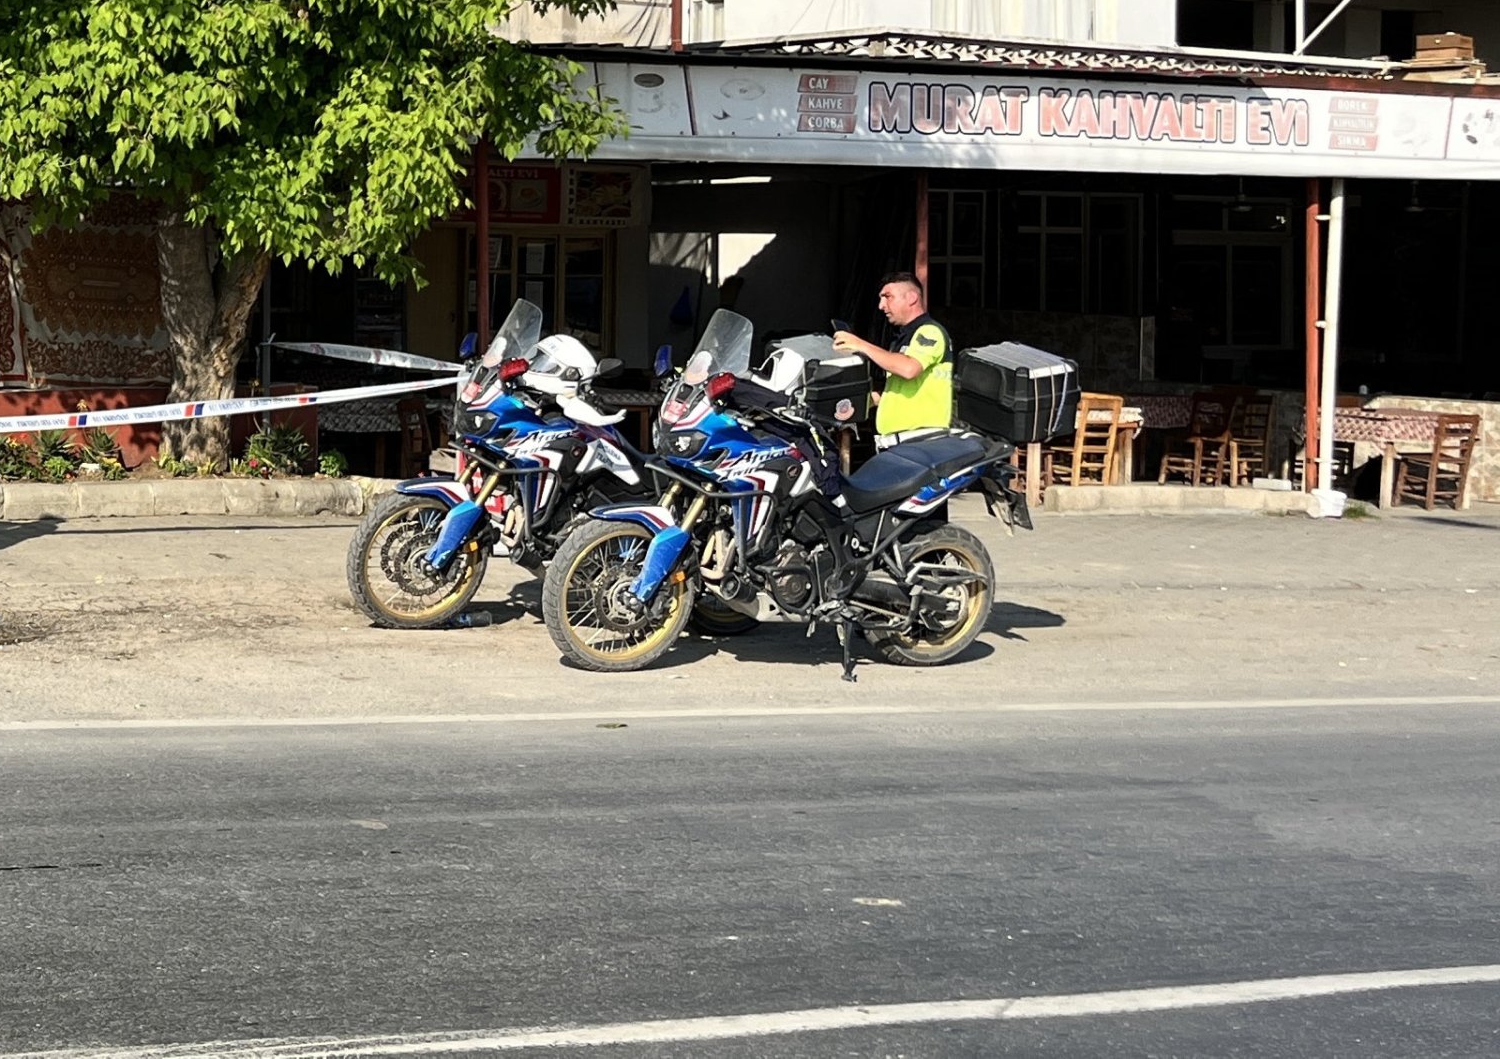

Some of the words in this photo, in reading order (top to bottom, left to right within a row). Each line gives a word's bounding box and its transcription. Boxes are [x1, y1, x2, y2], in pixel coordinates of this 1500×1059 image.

[808, 96, 843, 110] KAHVE
[868, 81, 1030, 136] MURAT
[1038, 87, 1237, 144] KAHVALTI
